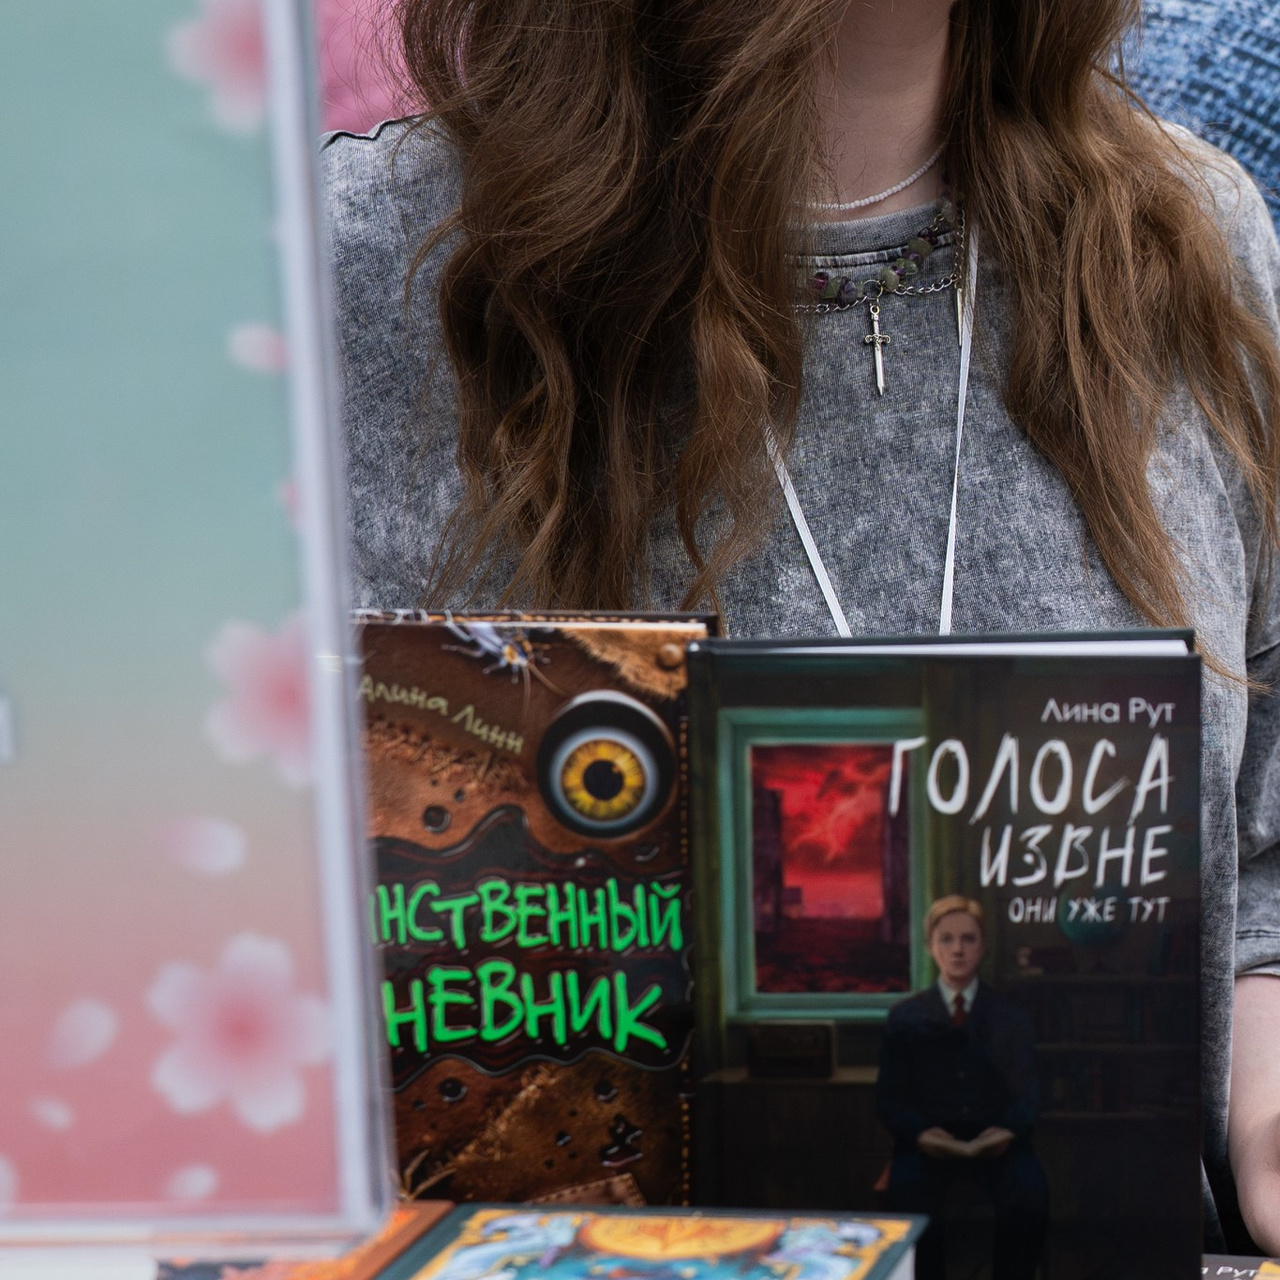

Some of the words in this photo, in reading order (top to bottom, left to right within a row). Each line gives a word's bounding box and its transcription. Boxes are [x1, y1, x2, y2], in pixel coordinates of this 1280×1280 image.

[357, 672, 448, 715] Алина
[452, 704, 525, 755] Линн
[1041, 697, 1121, 724] Лина
[1129, 697, 1176, 726] Рут
[887, 731, 1176, 825] ГОЛОСА
[979, 823, 1173, 889] ИЗВНЕ
[1009, 895, 1057, 924] ОНИ
[1066, 895, 1117, 924] УЖЕ
[1129, 895, 1170, 924] ТУТ
